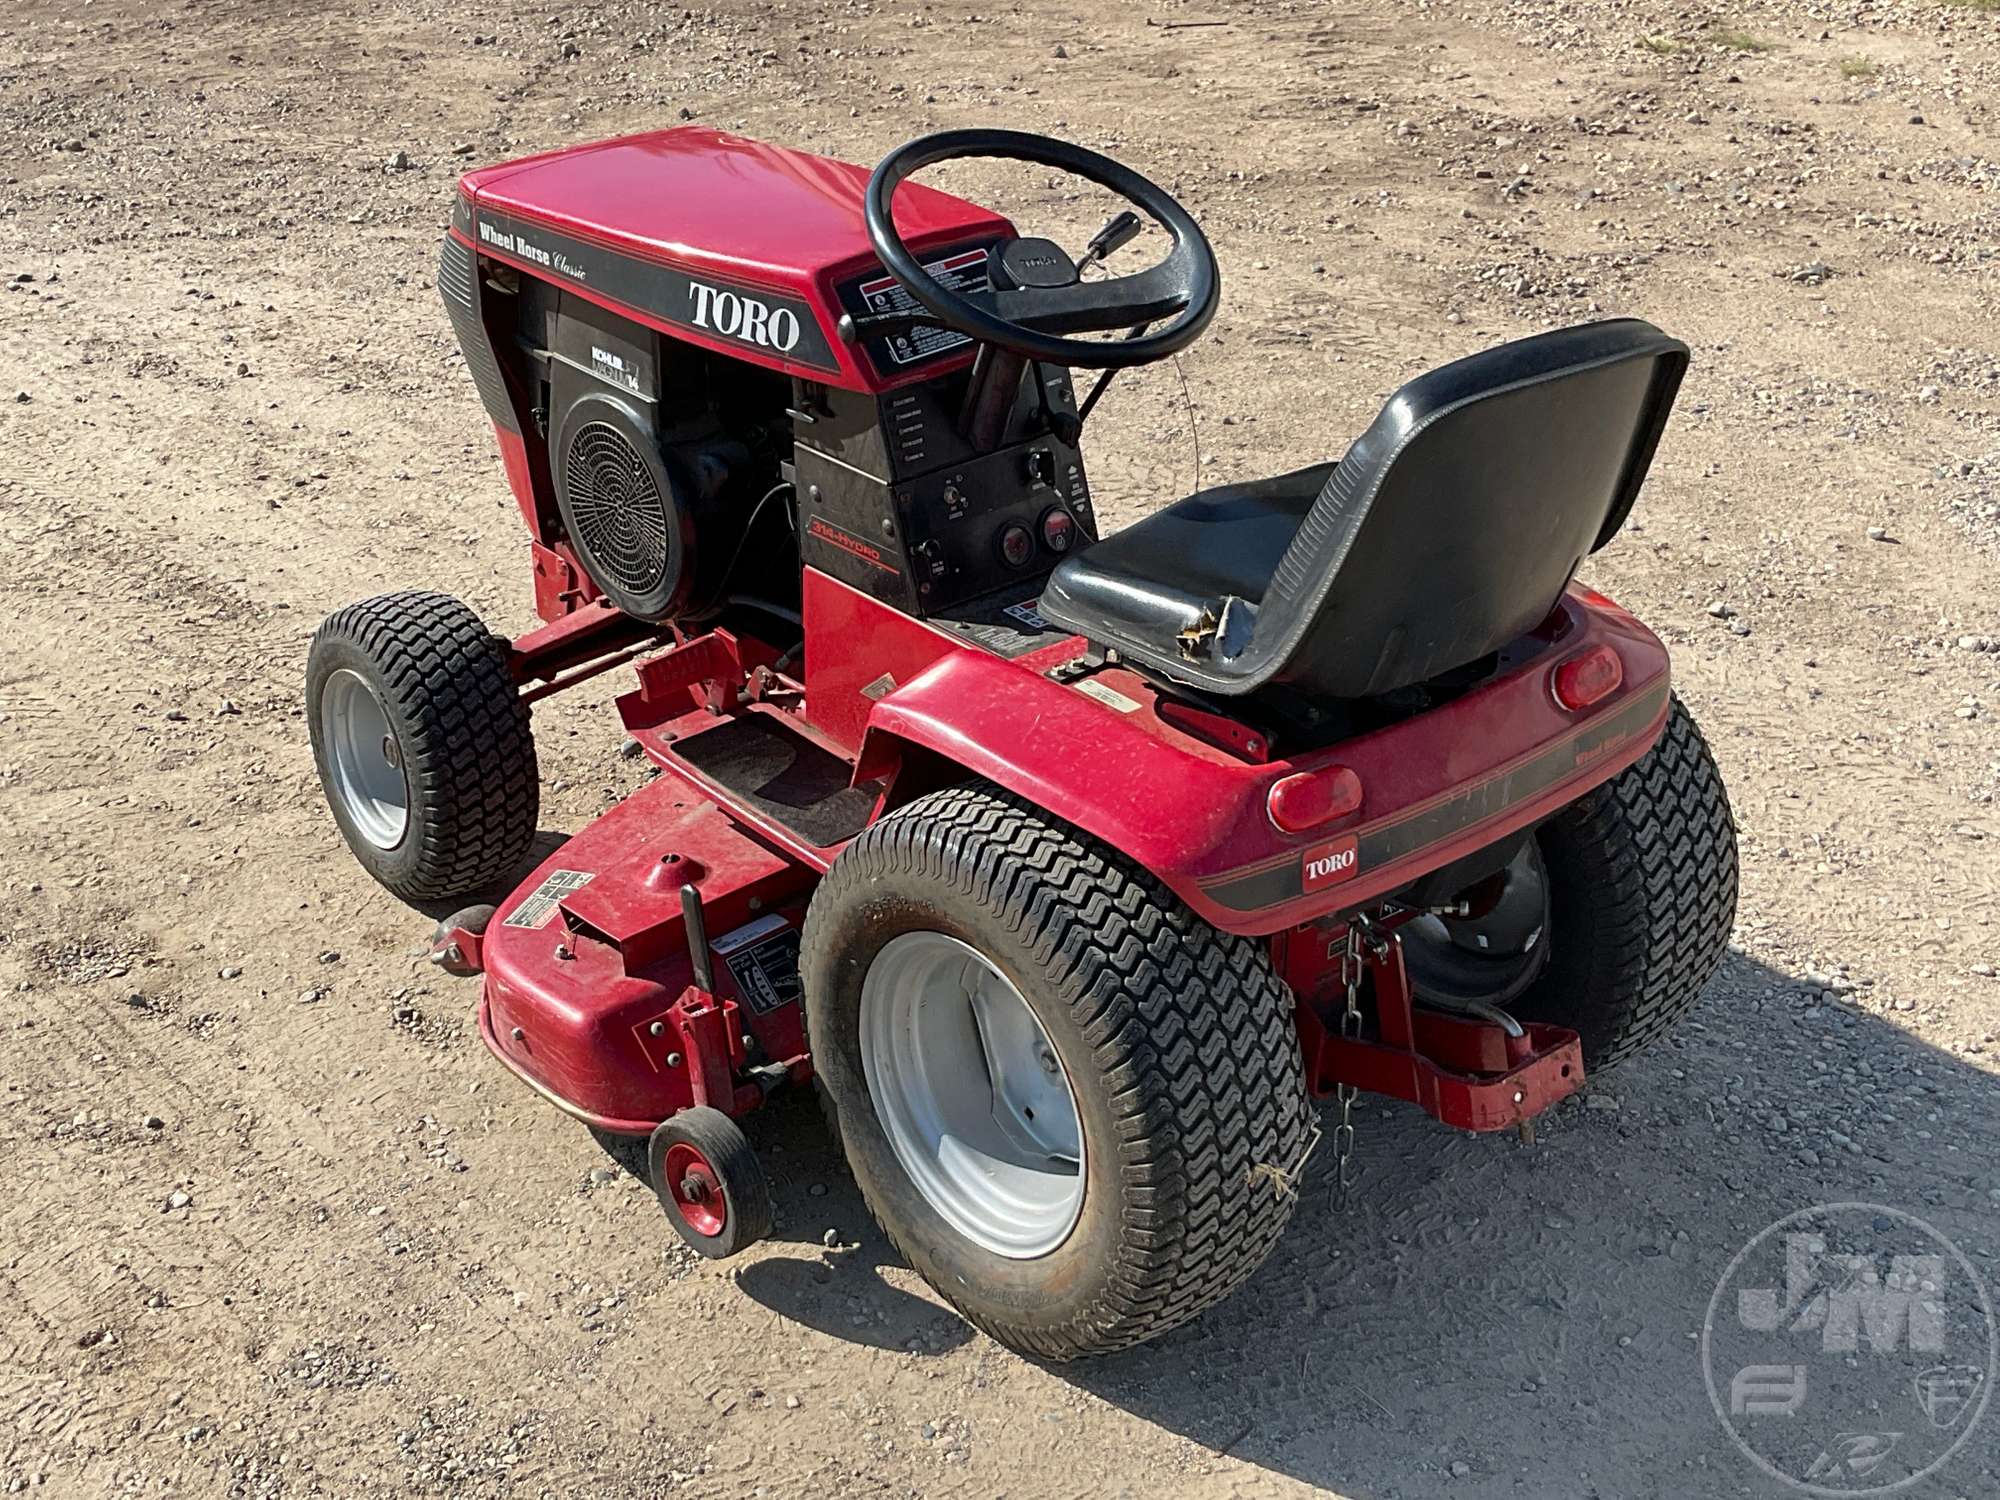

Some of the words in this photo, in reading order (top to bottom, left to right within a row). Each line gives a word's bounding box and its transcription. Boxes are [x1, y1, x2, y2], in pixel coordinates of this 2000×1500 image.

[479, 221, 515, 252] Wheel
[516, 236, 550, 266] Horse
[552, 251, 587, 280] Classic
[688, 281, 800, 352] TORO
[1305, 849, 1355, 880] TORO
